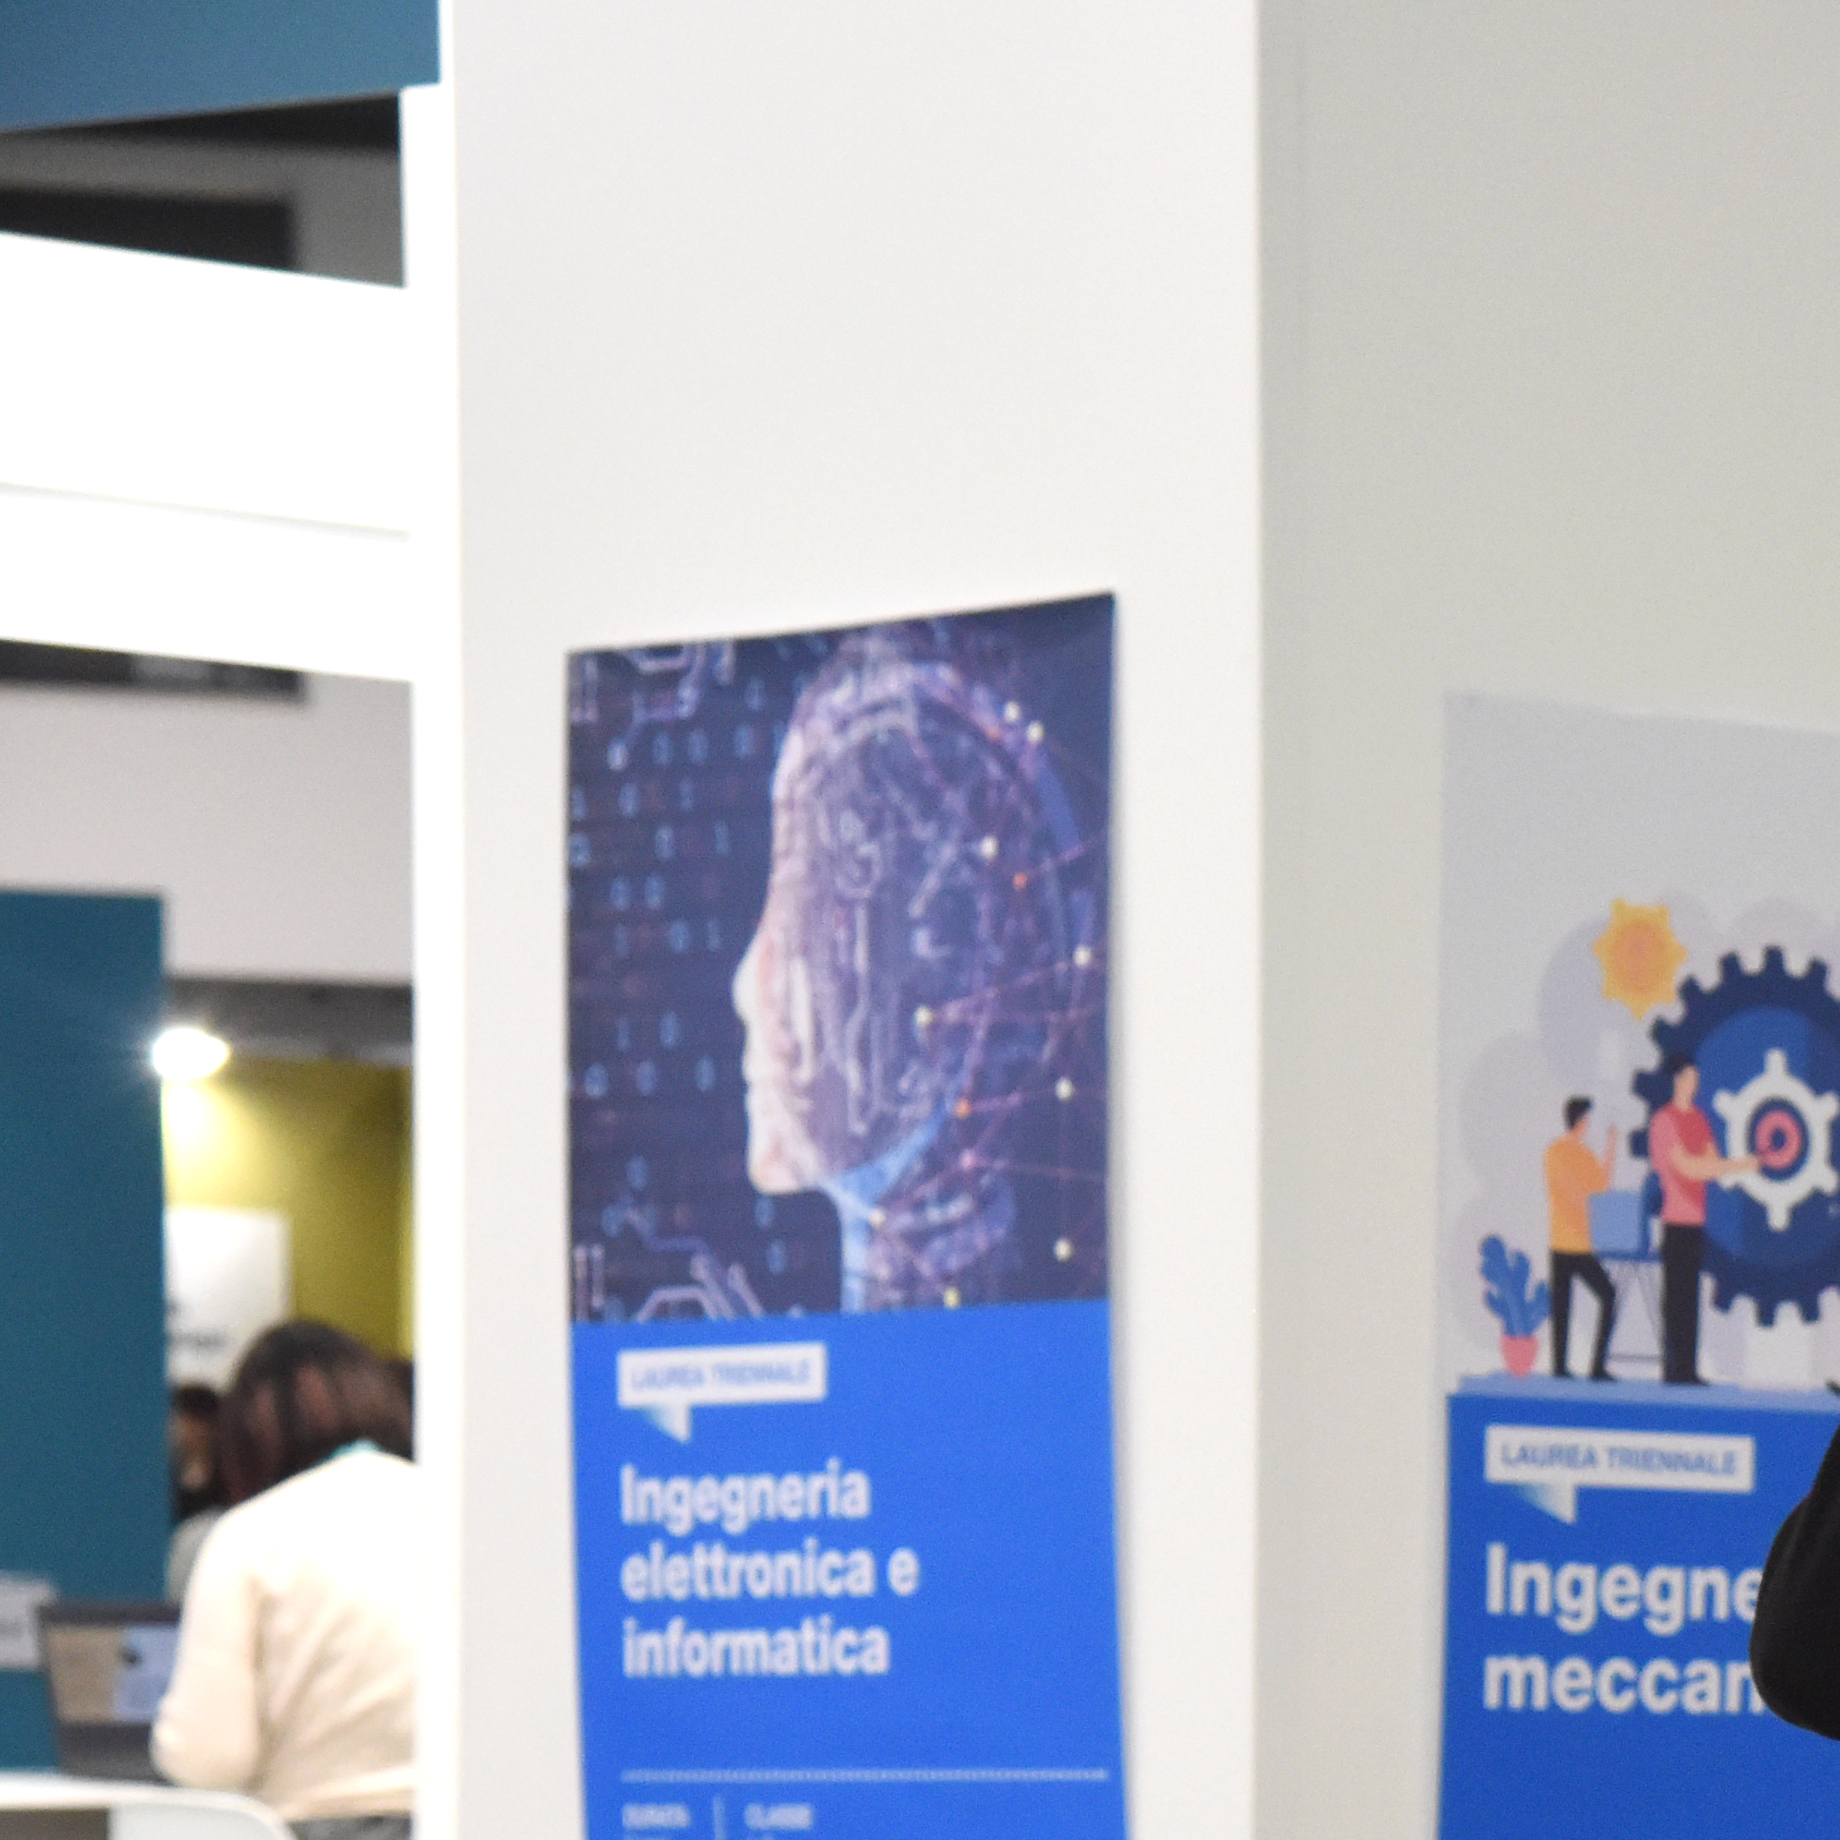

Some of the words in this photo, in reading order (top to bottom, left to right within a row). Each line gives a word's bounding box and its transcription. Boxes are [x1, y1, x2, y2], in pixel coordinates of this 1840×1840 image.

[1502, 1443, 1598, 1469] LAUREA
[1608, 1446, 1737, 1477] TRIENNALE
[621, 1457, 872, 1535] Ingegneria
[621, 1534, 877, 1602] elettronica
[887, 1547, 921, 1597] e
[623, 1613, 891, 1678] informatica
